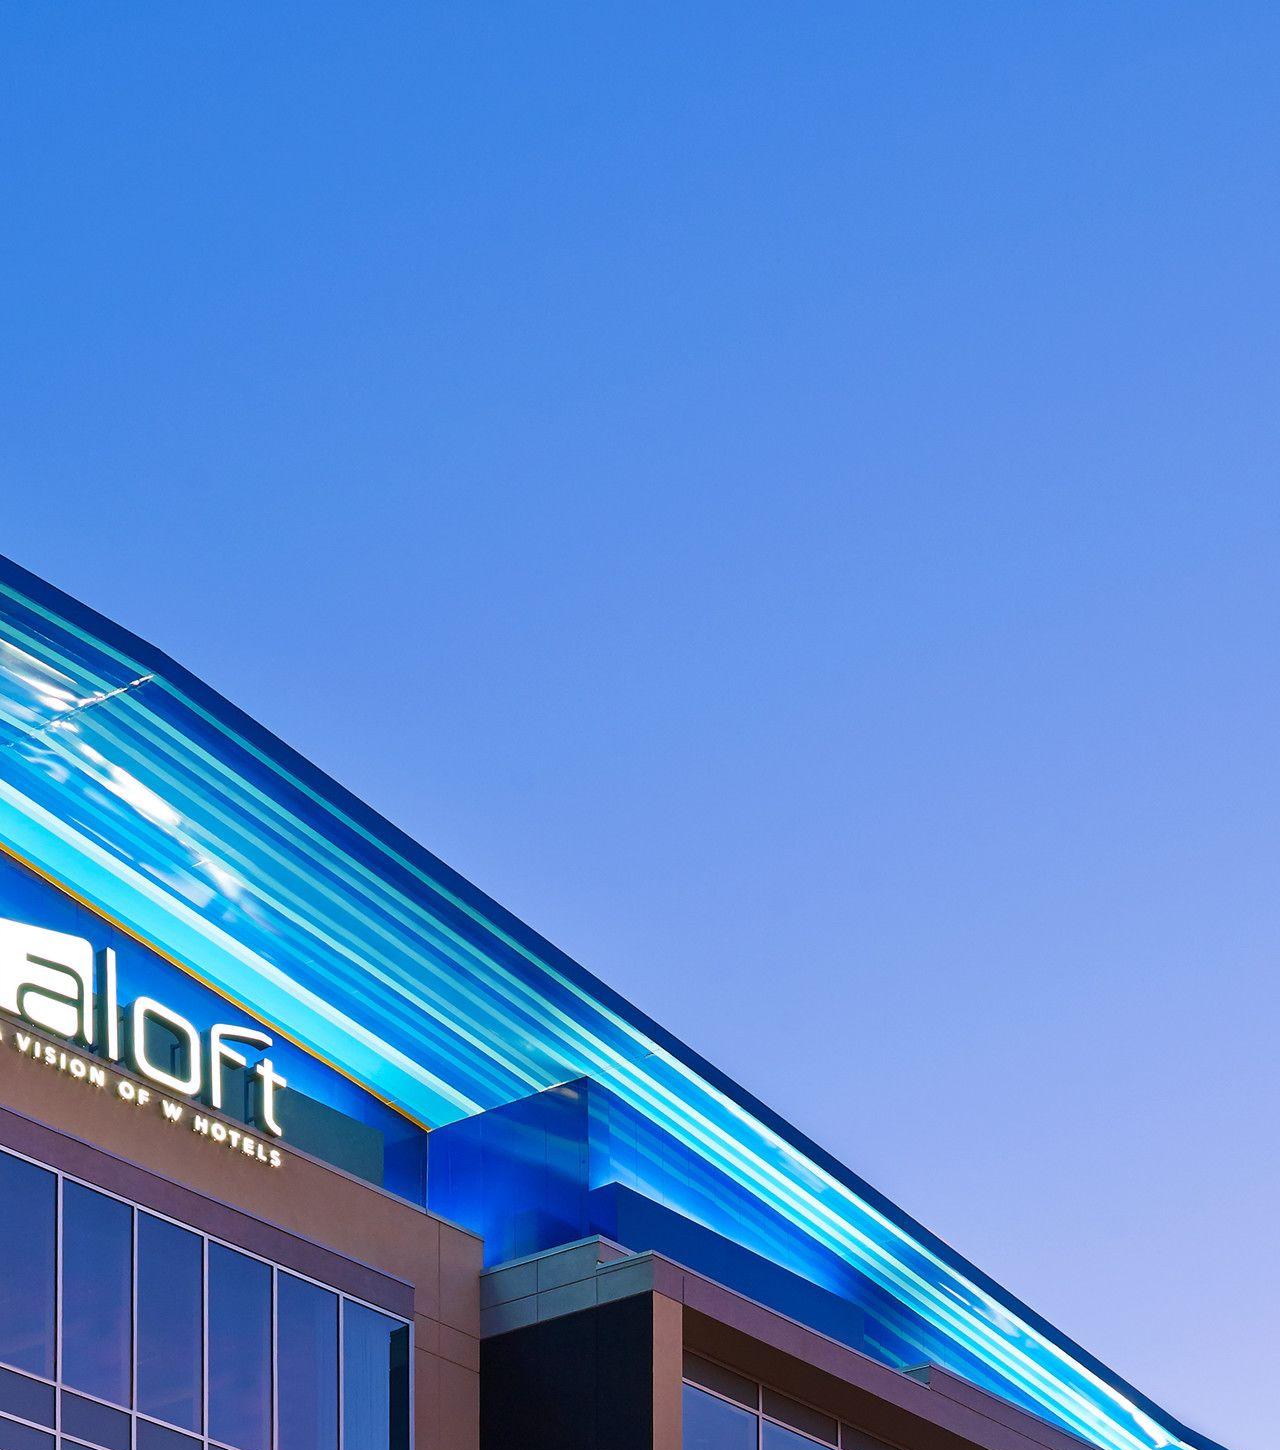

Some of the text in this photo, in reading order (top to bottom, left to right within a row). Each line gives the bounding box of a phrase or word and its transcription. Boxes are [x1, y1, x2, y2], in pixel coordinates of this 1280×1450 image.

[16, 1032, 107, 1088] VISION
[117, 1079, 151, 1107] OF
[158, 1100, 184, 1123] W
[193, 1115, 284, 1169] HOTELS
